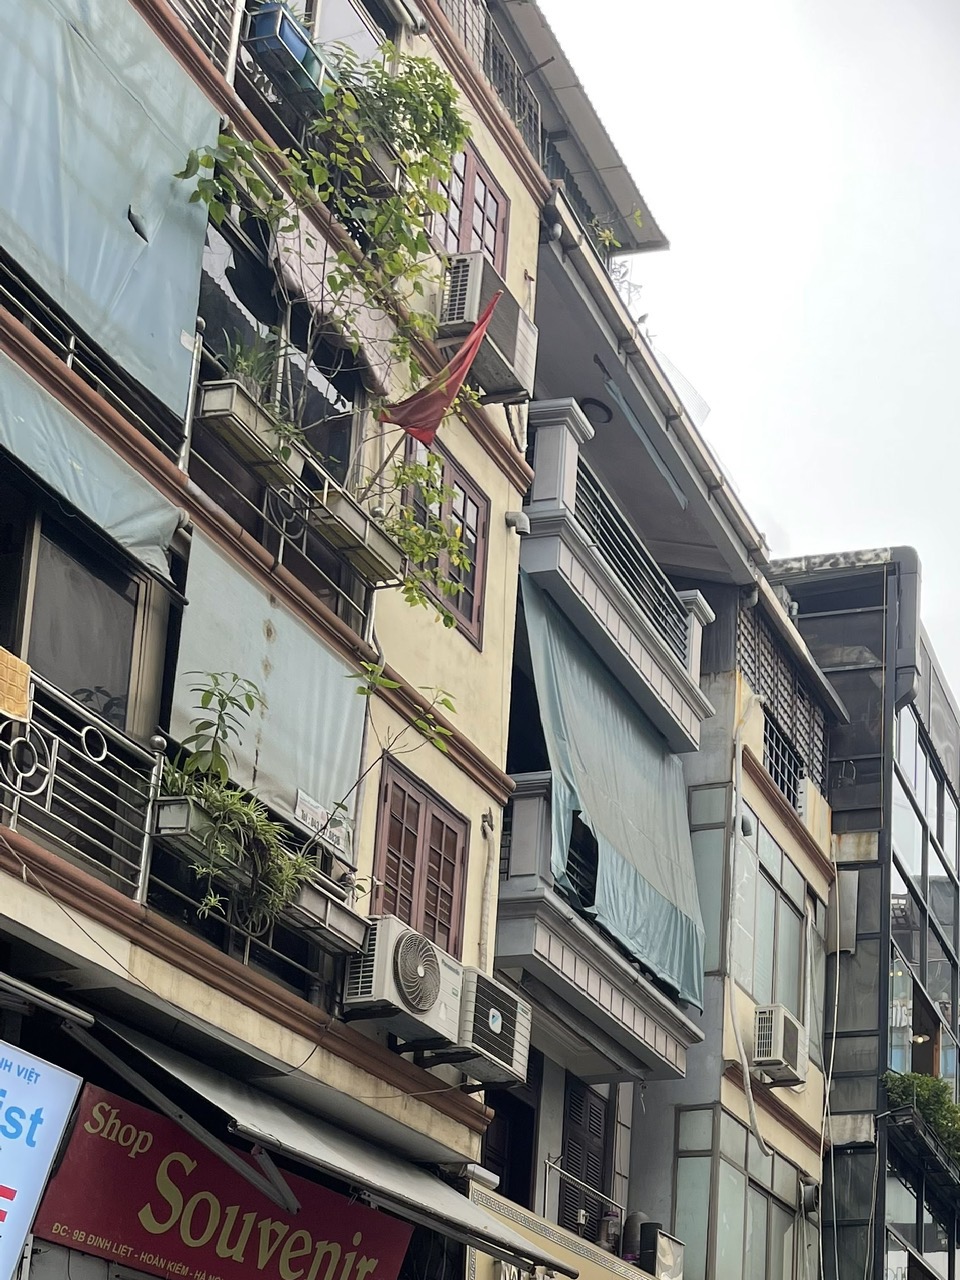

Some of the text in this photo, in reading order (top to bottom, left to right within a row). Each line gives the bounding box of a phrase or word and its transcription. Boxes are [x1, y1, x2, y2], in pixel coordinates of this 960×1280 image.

[17, 1063, 41, 1086] VIỆT
[83, 1102, 153, 1159] Shop
[52, 1222, 71, 1238] ĐC:
[72, 1228, 87, 1243] 9B
